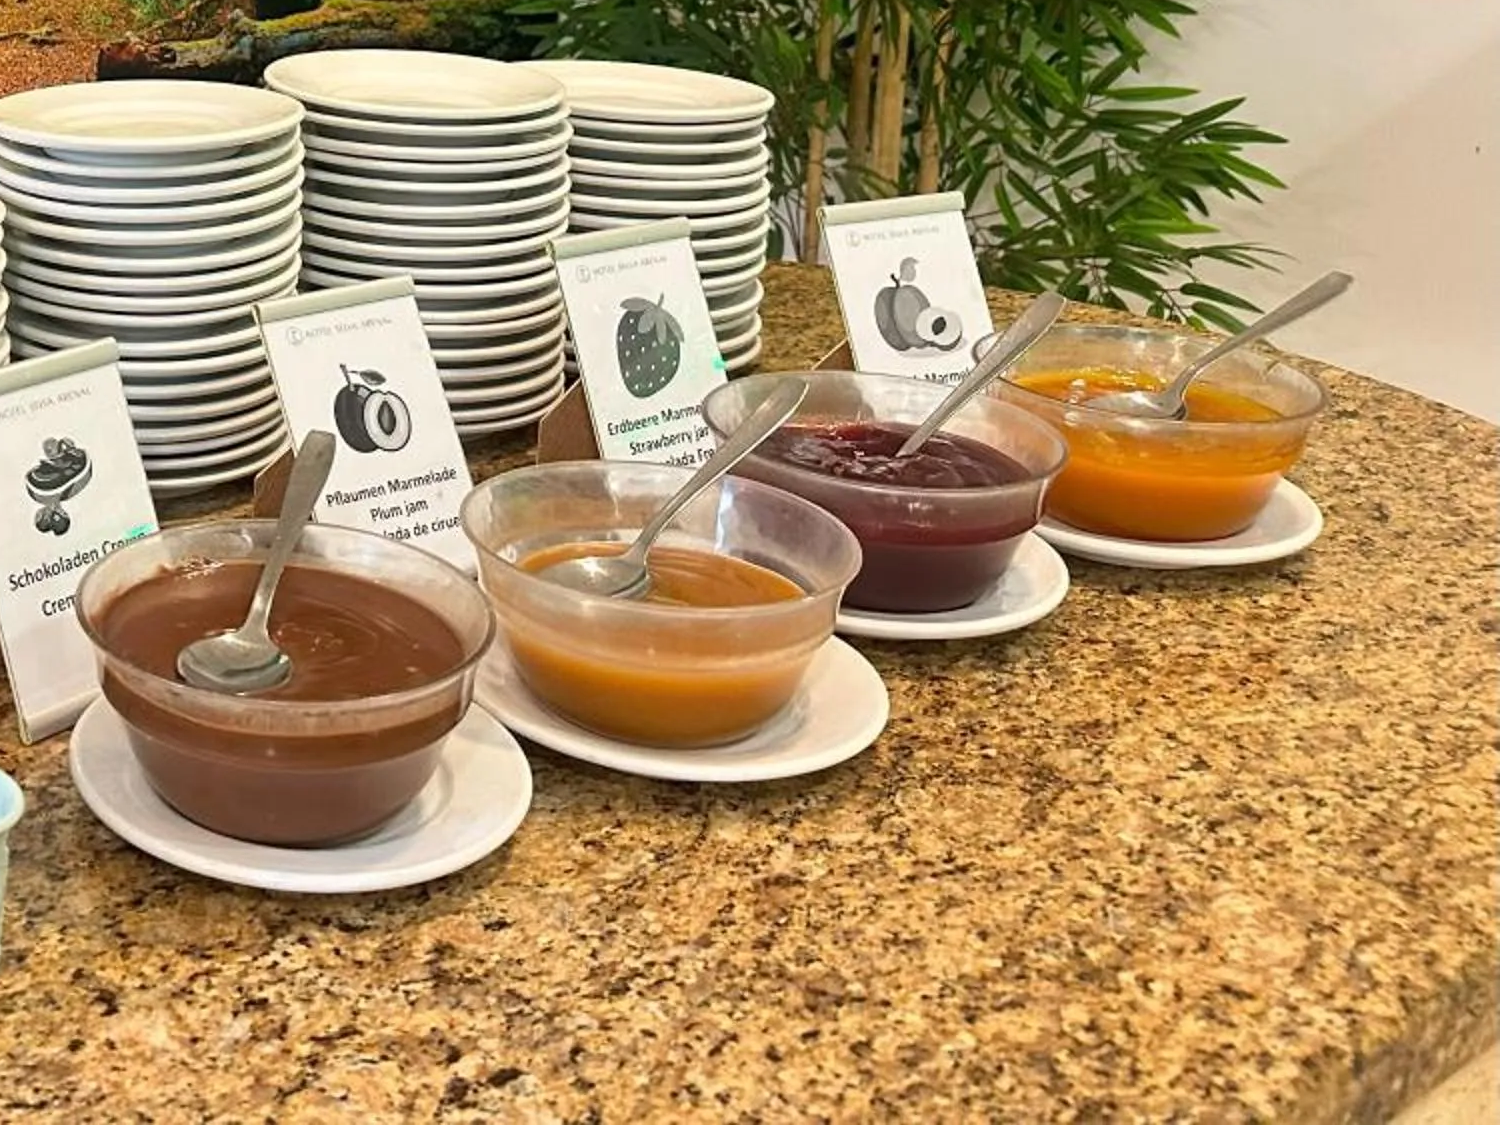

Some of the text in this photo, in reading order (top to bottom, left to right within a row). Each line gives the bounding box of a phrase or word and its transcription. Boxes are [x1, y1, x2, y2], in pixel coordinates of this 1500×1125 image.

[607, 415, 659, 436] Erdbeere
[629, 431, 693, 456] Strawberry
[325, 467, 457, 507] Pflaumen Marmelade
[370, 499, 429, 522] Plum jam
[413, 521, 429, 536] de
[8, 548, 99, 592] Schokoladen
